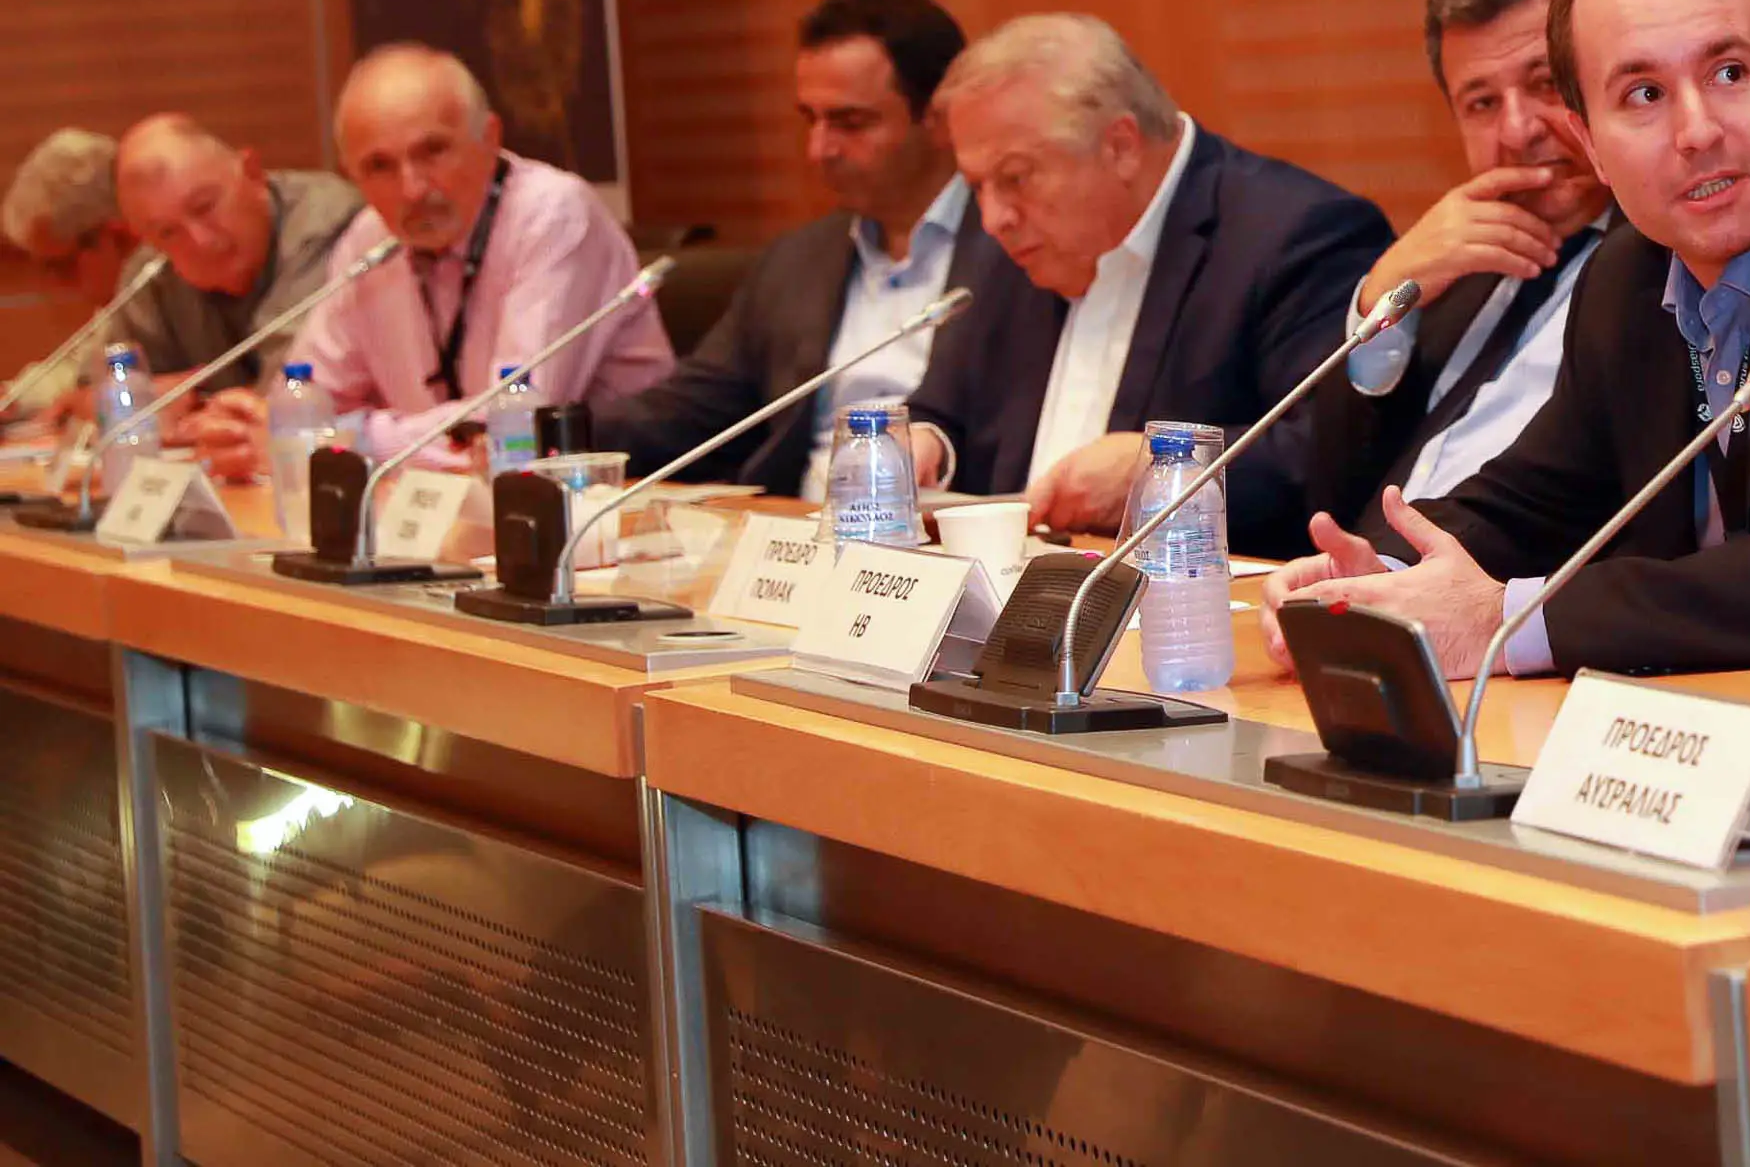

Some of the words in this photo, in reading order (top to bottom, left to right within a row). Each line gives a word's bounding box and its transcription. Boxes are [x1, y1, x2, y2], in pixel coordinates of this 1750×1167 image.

[764, 539, 819, 566] ΠΡΟΕΔΡΟ
[851, 569, 919, 601] ΠΡΟΕΔΡΟΣ
[1603, 716, 1711, 768] ΠΡΟΕΔΡΟΣ
[1575, 771, 1684, 826] ΑΥΣΡΑΛΙΑΣ
